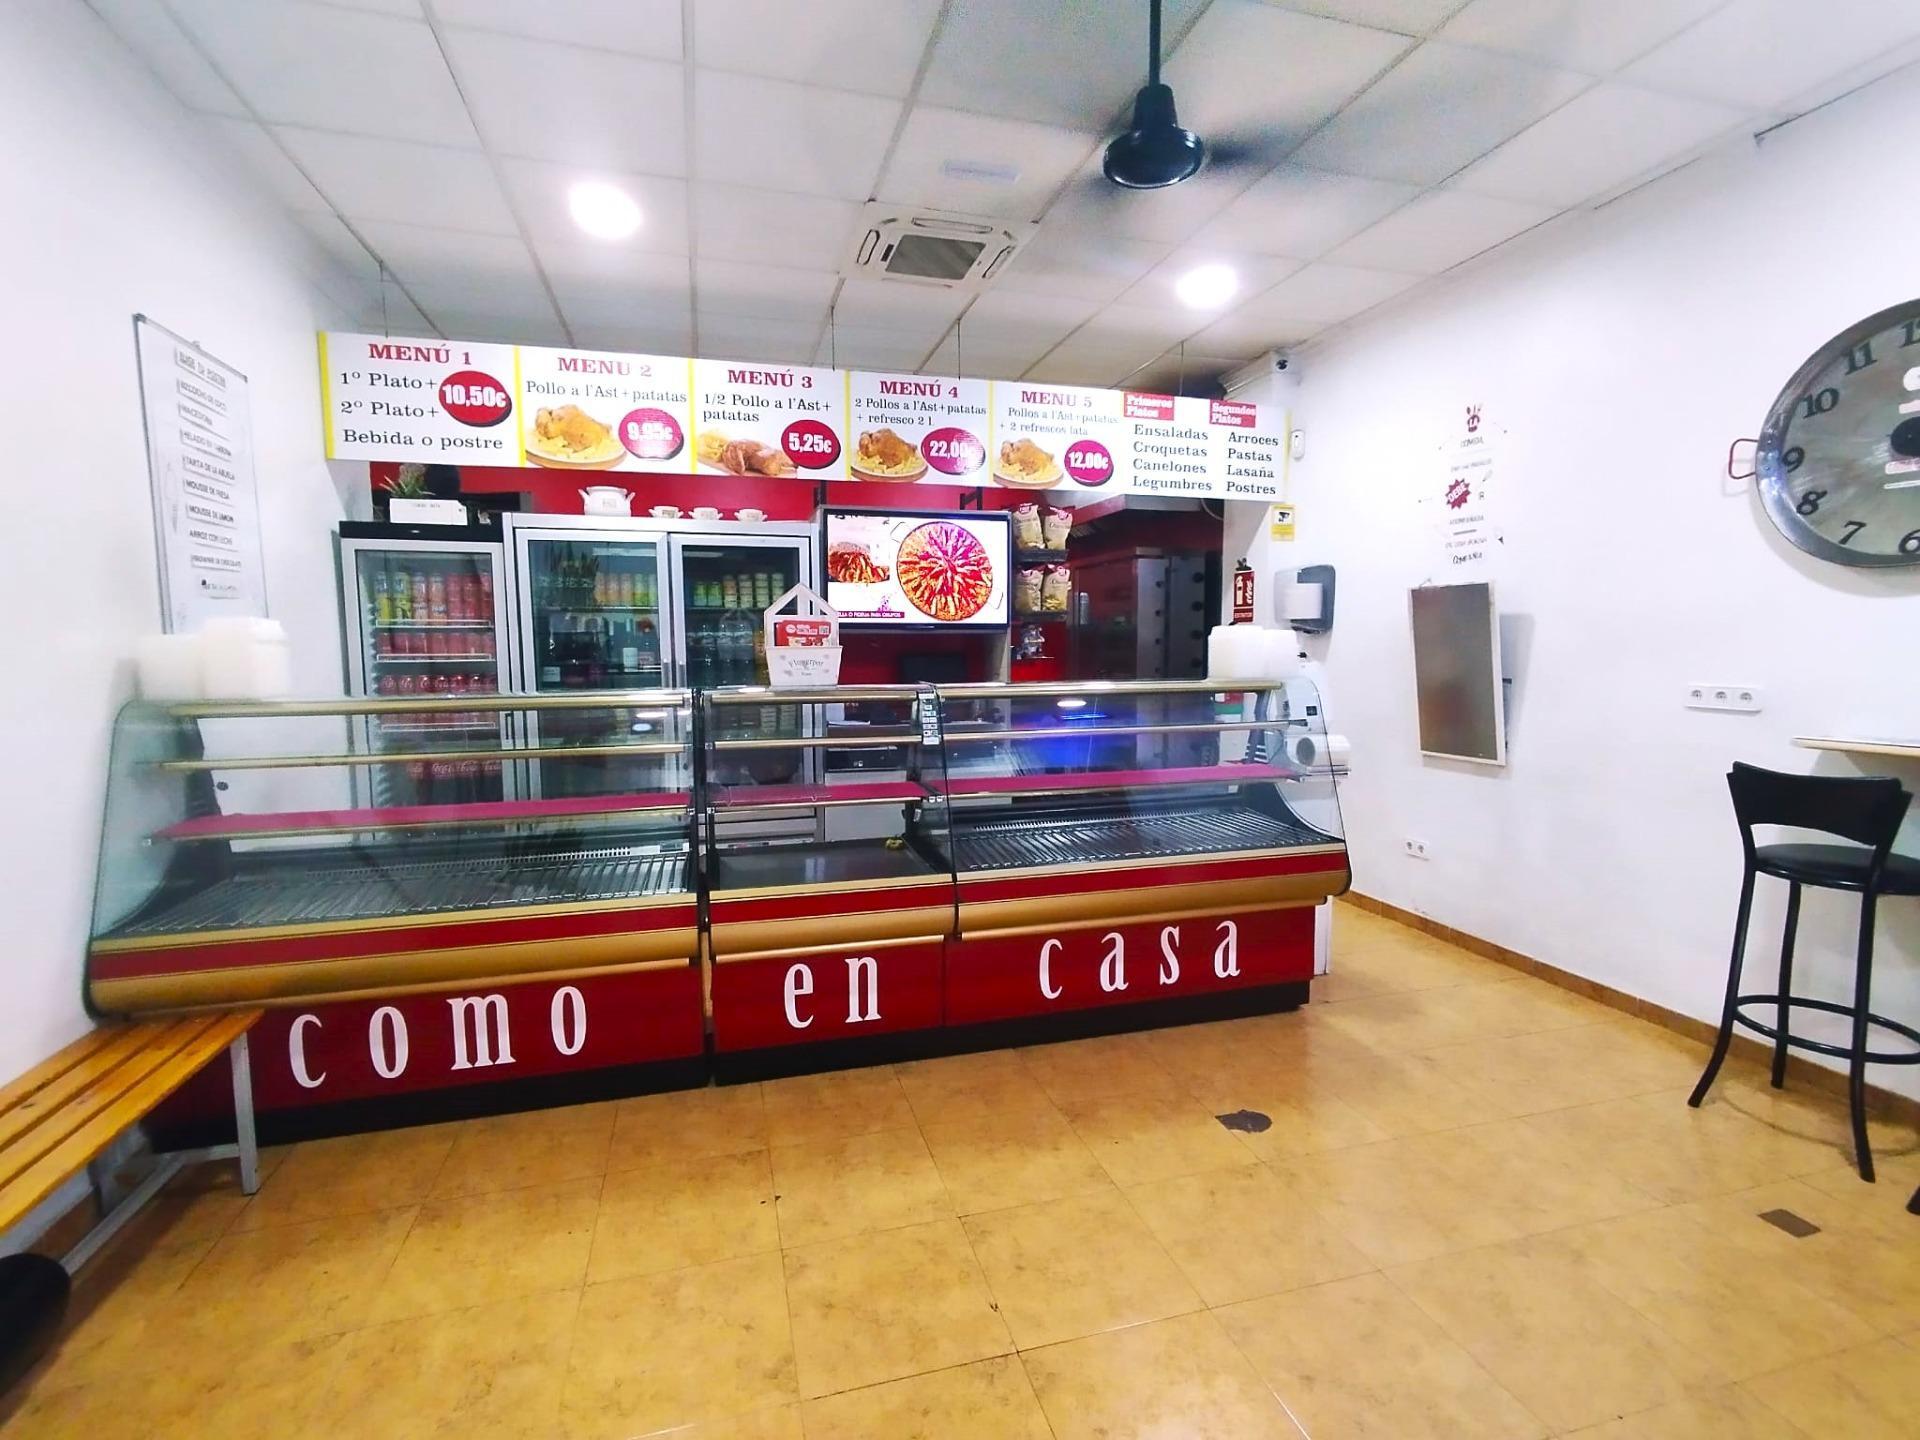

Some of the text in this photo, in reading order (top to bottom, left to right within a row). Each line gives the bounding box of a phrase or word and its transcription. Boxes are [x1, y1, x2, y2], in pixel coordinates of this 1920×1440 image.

[368, 343, 472, 365] MENÚ 1
[1845, 340, 1877, 375] 11
[640, 365, 652, 377] 2
[728, 368, 813, 389] MENÚ 3
[526, 380, 566, 396] Pollo
[571, 387, 579, 396] a
[879, 379, 958, 398] MENÚ 4
[340, 400, 363, 415] 2º
[705, 393, 725, 405] 1/2
[732, 394, 769, 408] Pollo
[774, 400, 783, 409] a
[855, 398, 862, 407] 2
[866, 398, 900, 410] Pollos
[903, 402, 910, 410] a
[1084, 396, 1092, 408] 5
[1800, 388, 1840, 419] 10
[703, 409, 760, 422] patatas
[868, 413, 914, 425] refresco
[917, 416, 925, 425] 2
[1008, 407, 1039, 419] Pollos
[1042, 411, 1048, 419] a
[1010, 422, 1017, 431] 2
[1020, 423, 1066, 434] refrescos
[1070, 426, 1088, 436] lata
[1134, 423, 1209, 441] Ensaladas
[343, 429, 503, 451] Bebida o postre
[1228, 431, 1279, 446] Arroces
[1133, 441, 1208, 457] Croquetas
[1228, 448, 1272, 462] Pastas
[1133, 458, 1207, 474] Canelones
[1782, 446, 1805, 473] 9
[1227, 464, 1275, 478] Lasaña
[1132, 475, 1212, 491] Legumbres
[1226, 481, 1276, 495] Postres
[1447, 482, 1467, 503] DEBE
[1795, 490, 1828, 516] 8
[1838, 520, 1867, 545] 7
[1898, 527, 1920, 554] 6
[289, 919, 1241, 1088] como en casa
